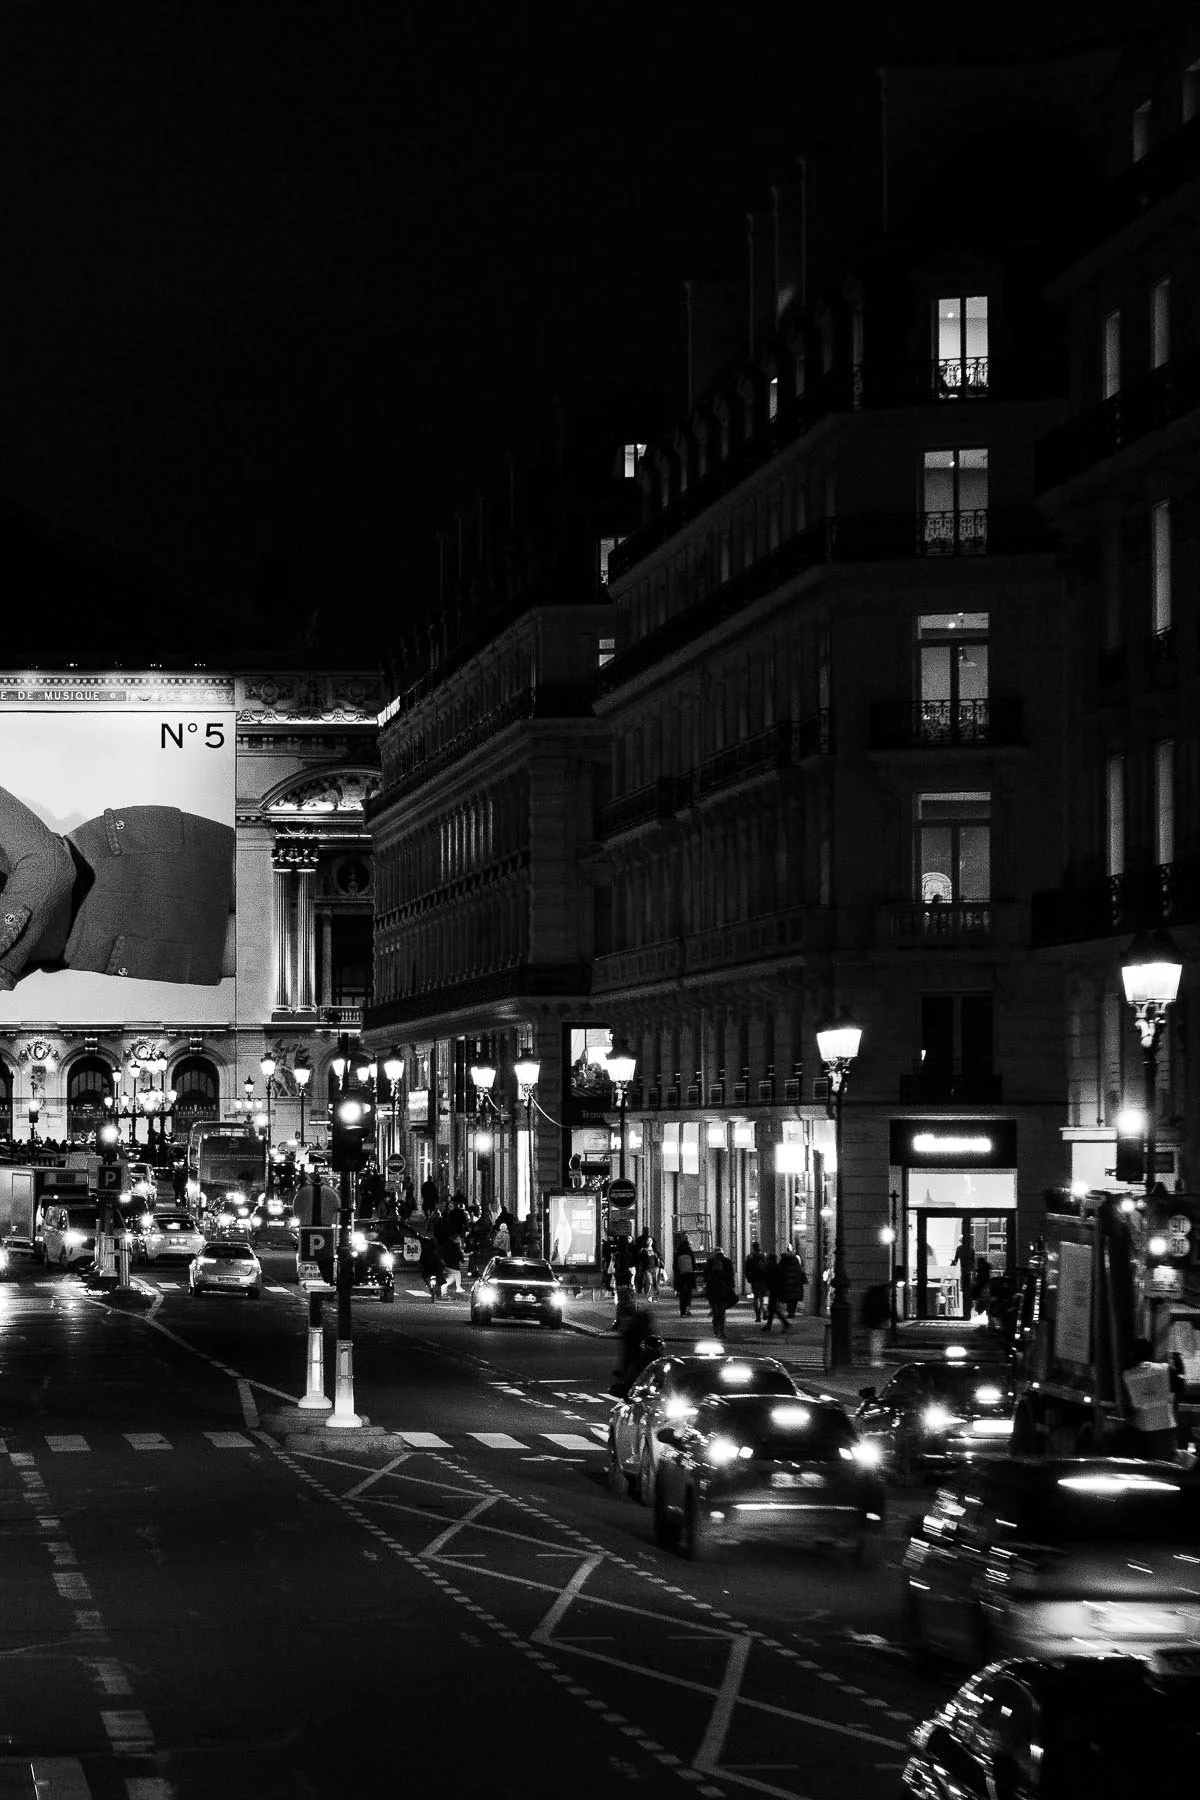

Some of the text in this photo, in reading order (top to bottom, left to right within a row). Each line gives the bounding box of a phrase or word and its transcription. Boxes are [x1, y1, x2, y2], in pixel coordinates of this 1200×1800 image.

[17, 690, 34, 700] DE
[44, 690, 100, 701] MUSIQUE
[160, 722, 225, 749] N°5
[104, 1170, 116, 1187] P
[309, 1233, 325, 1257] P
